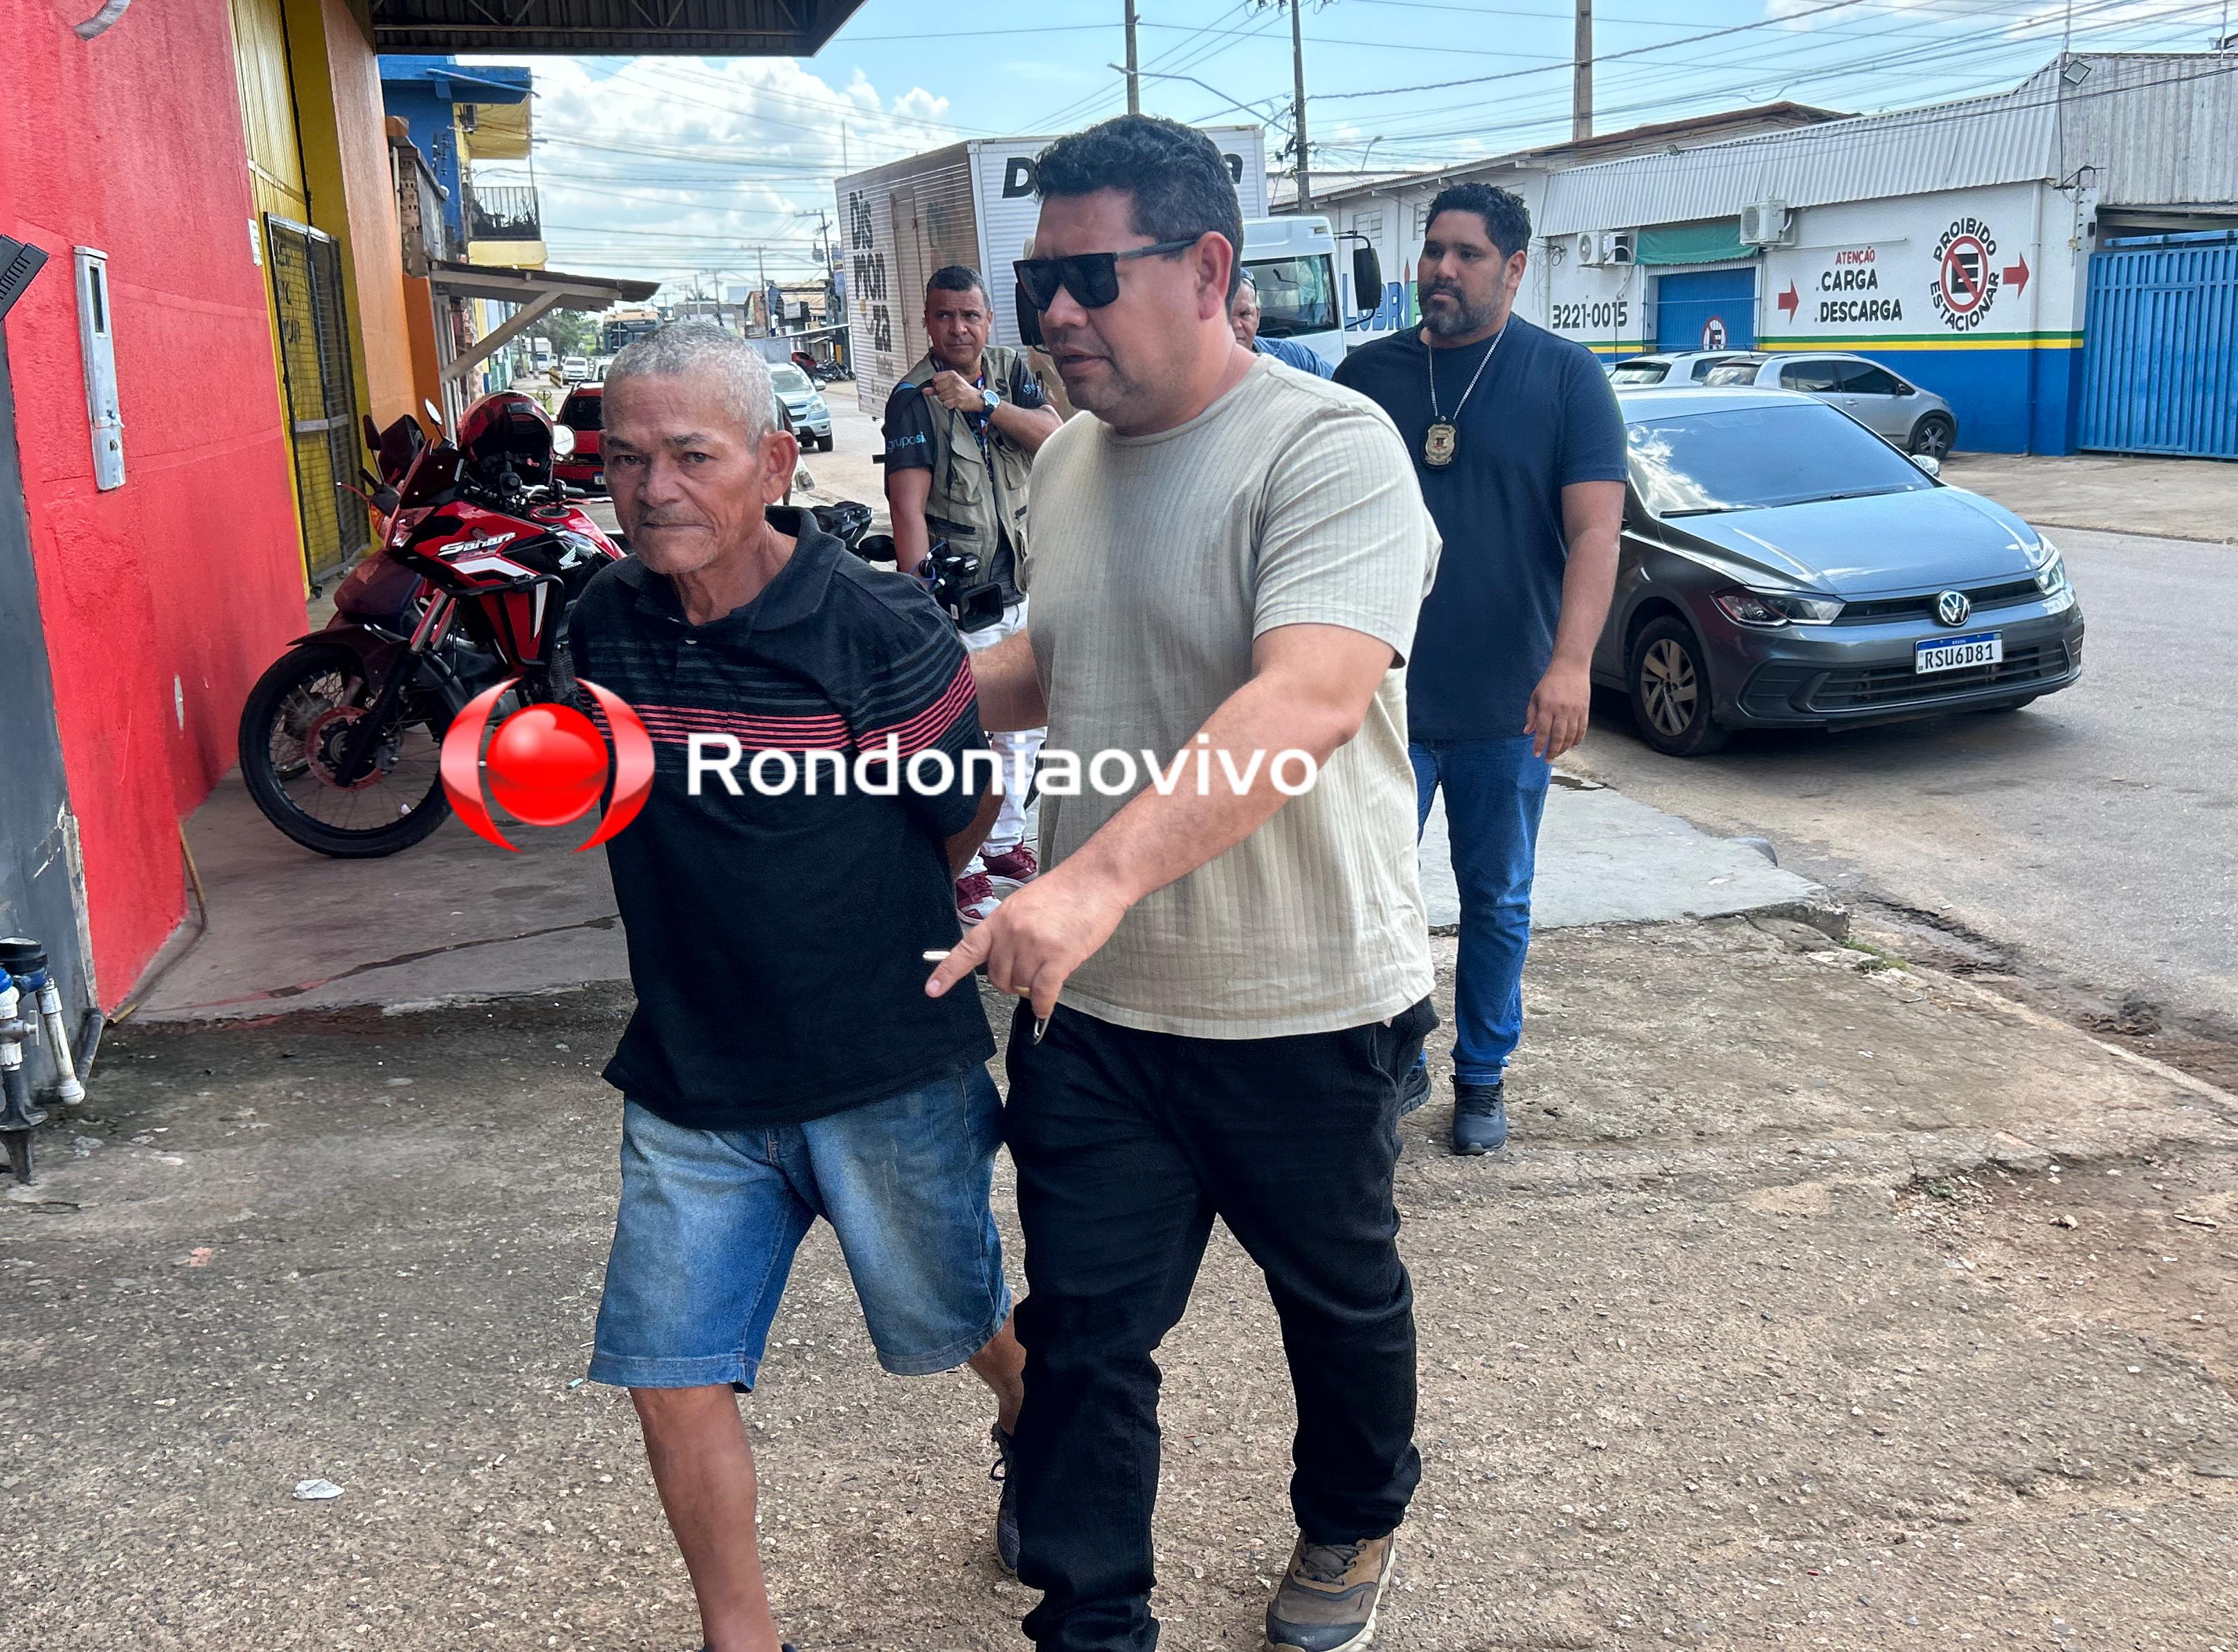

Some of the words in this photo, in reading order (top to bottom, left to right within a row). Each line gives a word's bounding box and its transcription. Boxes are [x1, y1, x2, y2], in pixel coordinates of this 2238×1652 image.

[1933, 217, 1996, 262] PROIBIDO
[1821, 269, 1878, 291] CARGA
[1552, 301, 1627, 329] 3221-0015
[1820, 298, 1902, 323] DESCARGA
[1930, 273, 1999, 332] ESTACIONAR
[1925, 643, 1994, 669] RSU6D81
